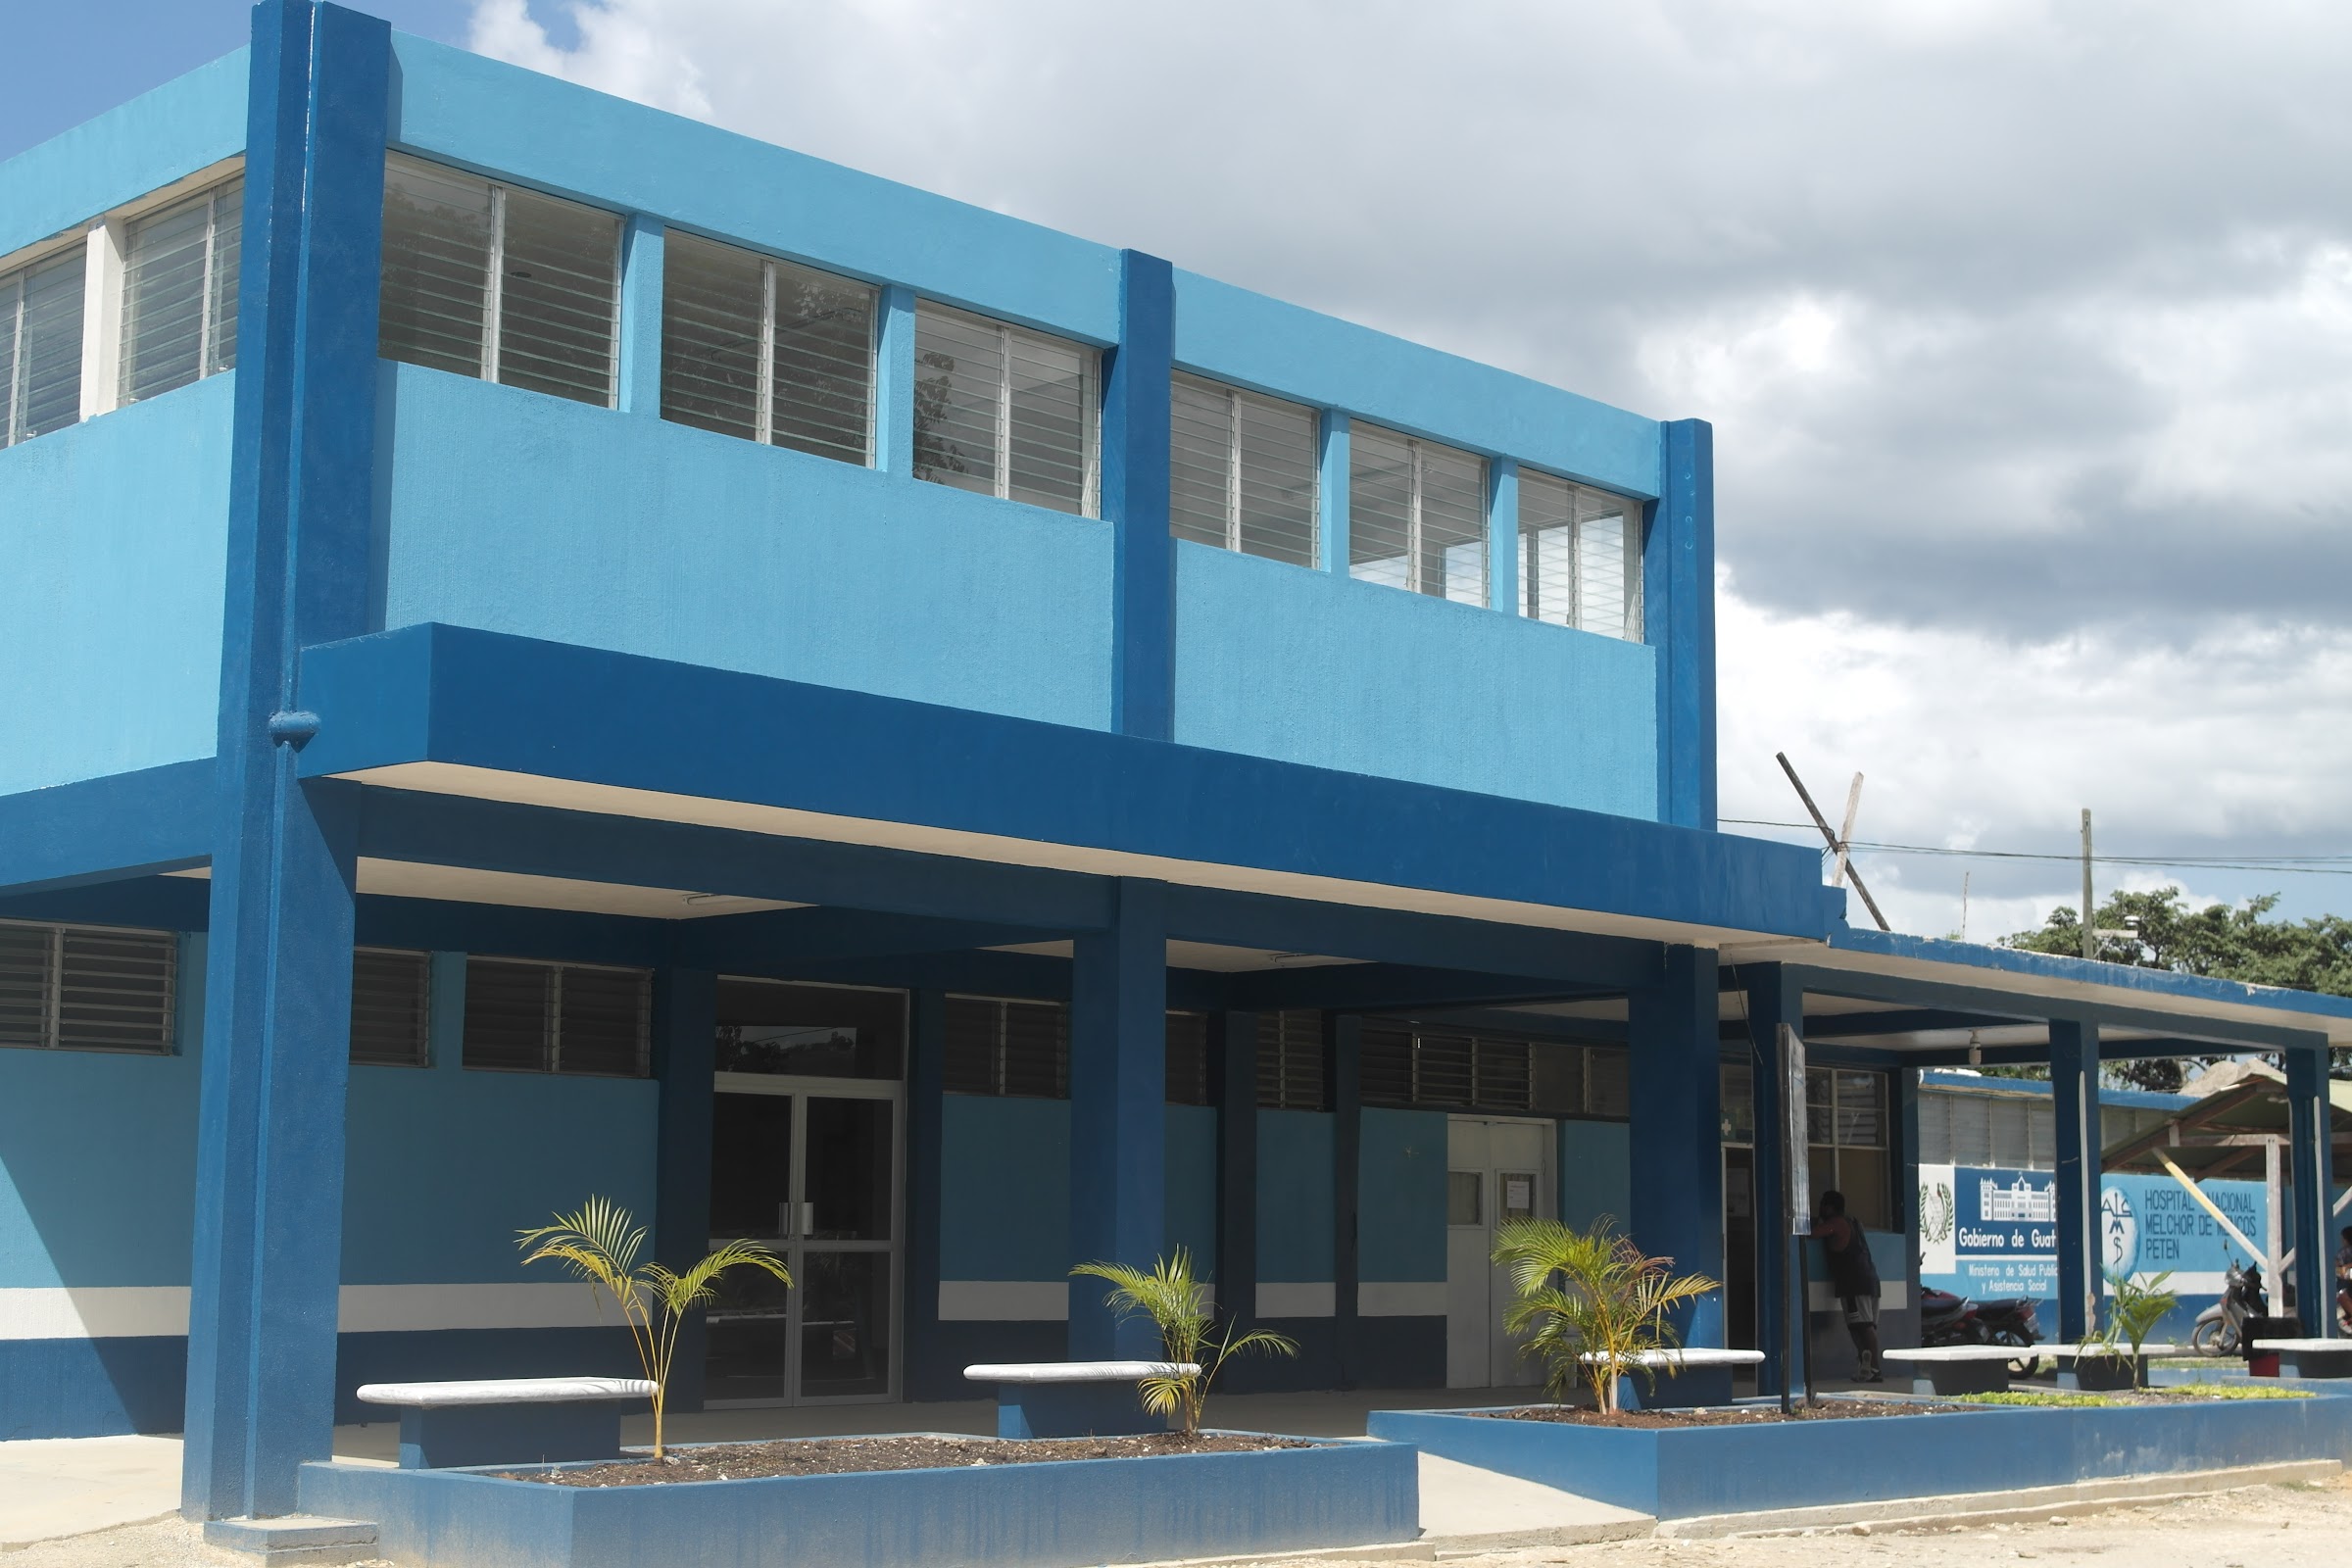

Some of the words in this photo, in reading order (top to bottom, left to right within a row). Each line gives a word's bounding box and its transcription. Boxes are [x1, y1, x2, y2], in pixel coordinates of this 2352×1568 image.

[2144, 1189, 2195, 1211] HOSPITAL
[2145, 1214, 2194, 1235] MELCHOR
[2198, 1214, 2213, 1236] DE
[2216, 1215, 2257, 1237] MNCOS
[1959, 1227, 2004, 1248] Gobierno
[2011, 1229, 2025, 1248] de
[2145, 1238, 2180, 1259] PETEN
[1968, 1263, 2000, 1277] Ministerio
[2005, 1264, 2015, 1277] de
[2018, 1263, 2036, 1277] Salud
[1981, 1282, 1986, 1295] y
[1988, 1279, 2025, 1292] Asistencia
[2028, 1279, 2047, 1292] Social
